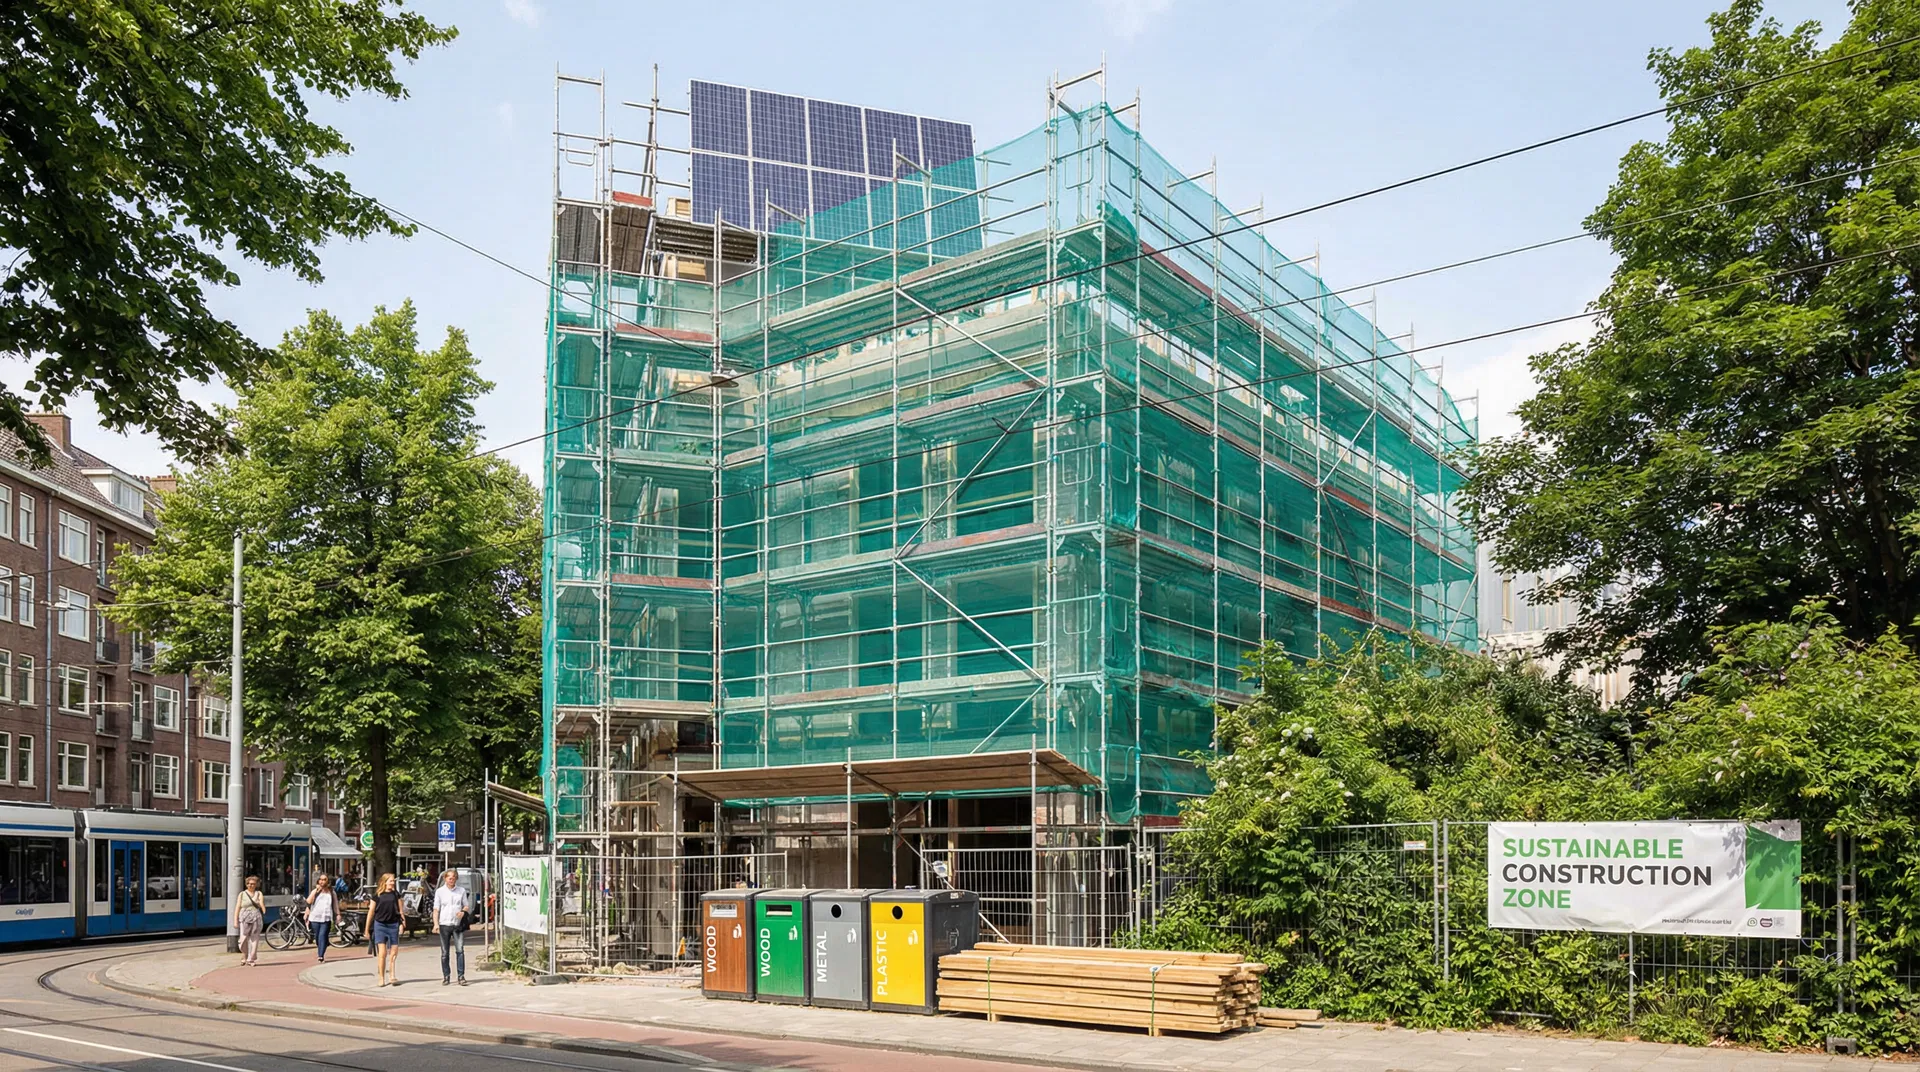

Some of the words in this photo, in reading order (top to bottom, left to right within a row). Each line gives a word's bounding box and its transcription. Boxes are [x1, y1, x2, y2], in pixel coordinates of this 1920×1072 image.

[1503, 838, 1683, 859] SUSTAINABLE
[1502, 863, 1712, 886] CONSTRUCTION
[1503, 888, 1571, 909] ZONE
[706, 925, 717, 973] WOOD
[760, 928, 771, 977] WOOD
[816, 930, 828, 983] METAL
[876, 929, 888, 996] PLASTIC
